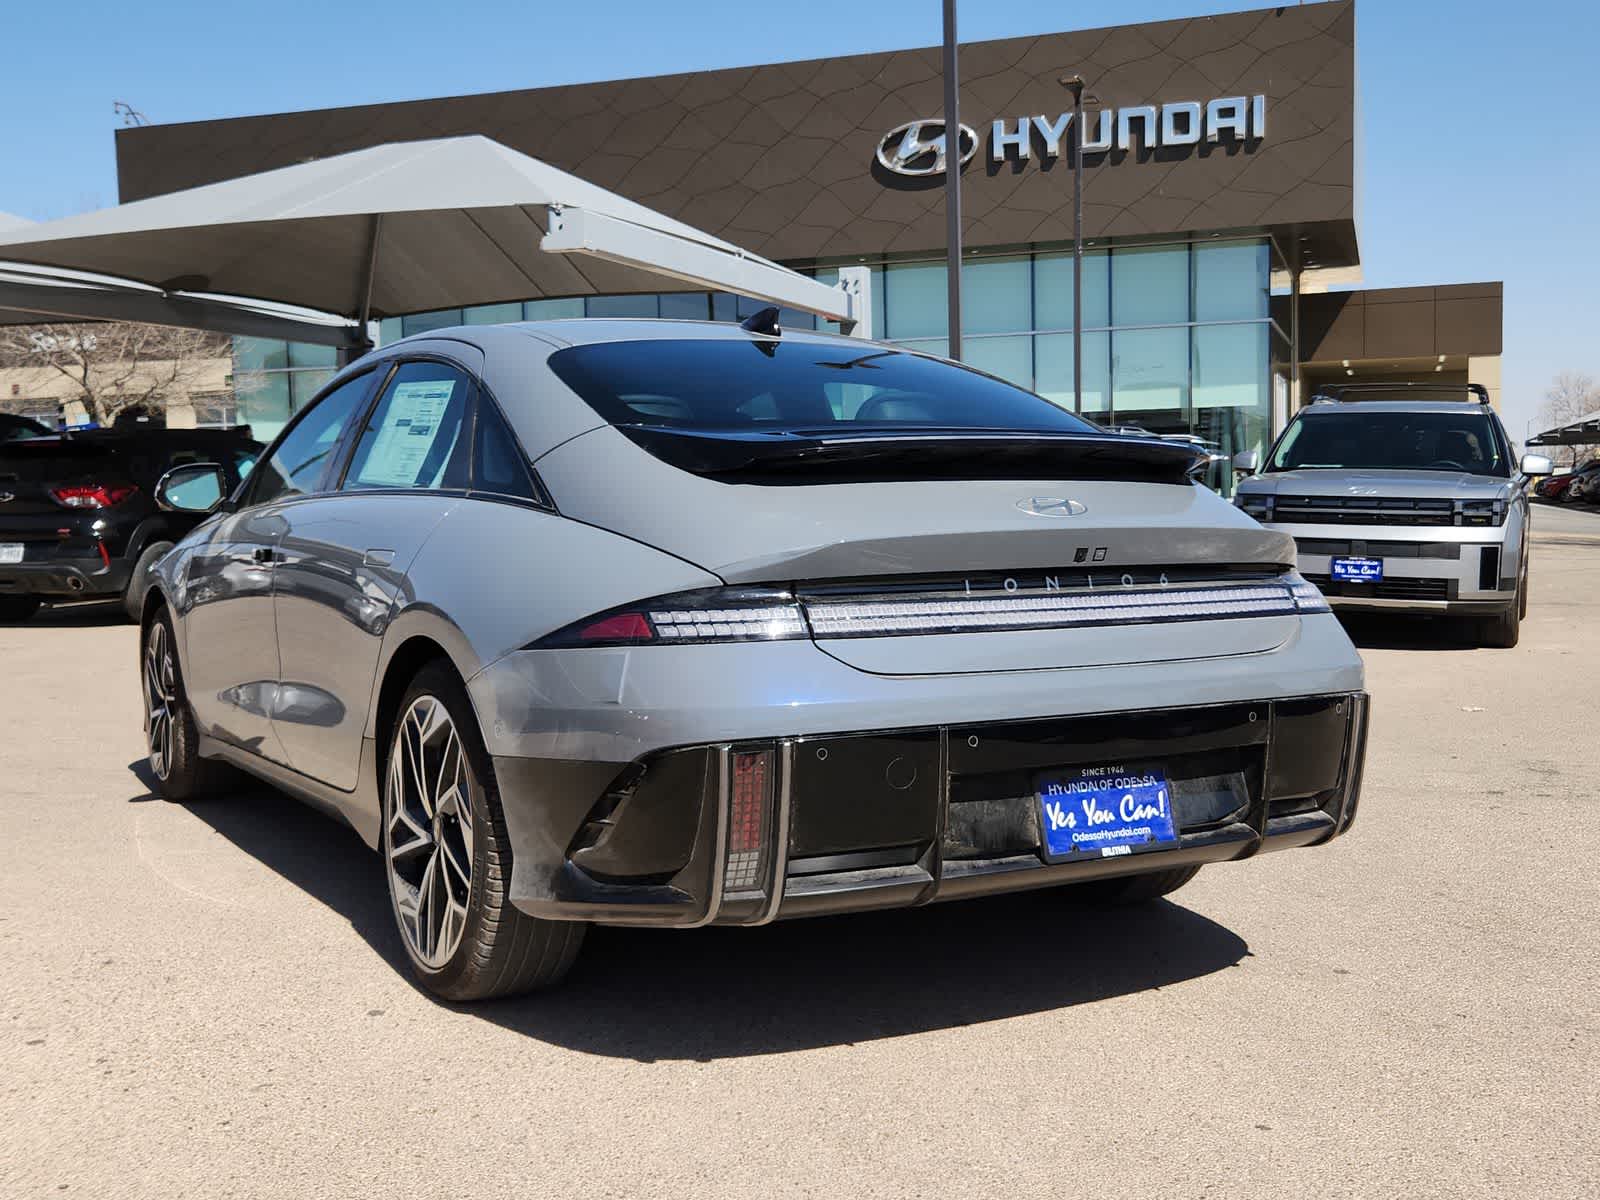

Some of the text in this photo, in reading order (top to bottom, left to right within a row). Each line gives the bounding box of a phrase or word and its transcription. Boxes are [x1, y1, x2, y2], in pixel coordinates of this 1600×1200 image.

[992, 94, 1265, 161] HYUNDAI
[1159, 572, 1169, 587] 6
[1081, 767, 1105, 777] SINCE
[1048, 775, 1157, 796] HYUNDAI OF ODESSA
[1046, 790, 1165, 830] Yes You Can!
[1072, 826, 1151, 843] OdessaHyundai.com
